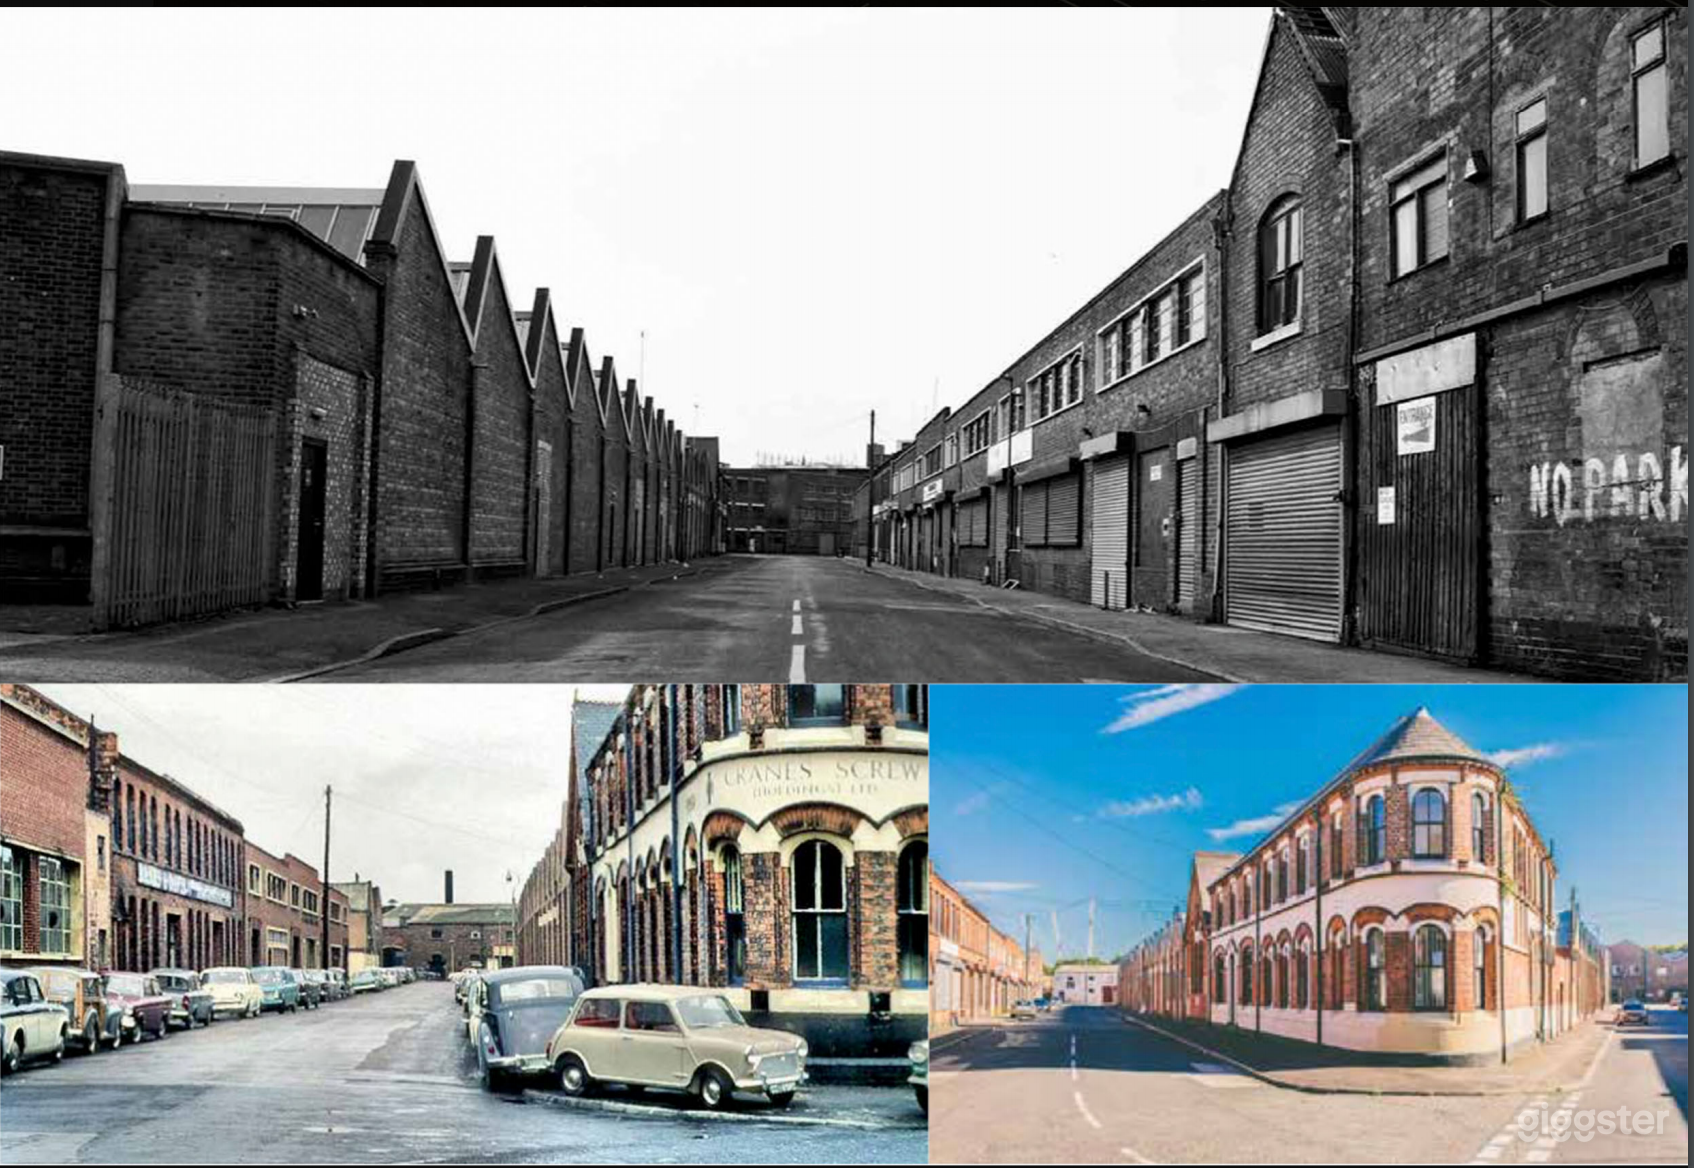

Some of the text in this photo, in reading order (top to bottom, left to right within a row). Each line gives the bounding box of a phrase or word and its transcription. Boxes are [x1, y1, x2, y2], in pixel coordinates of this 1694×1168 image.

[1530, 460, 1572, 527] NO
[724, 759, 921, 787] CRANES SCREW
